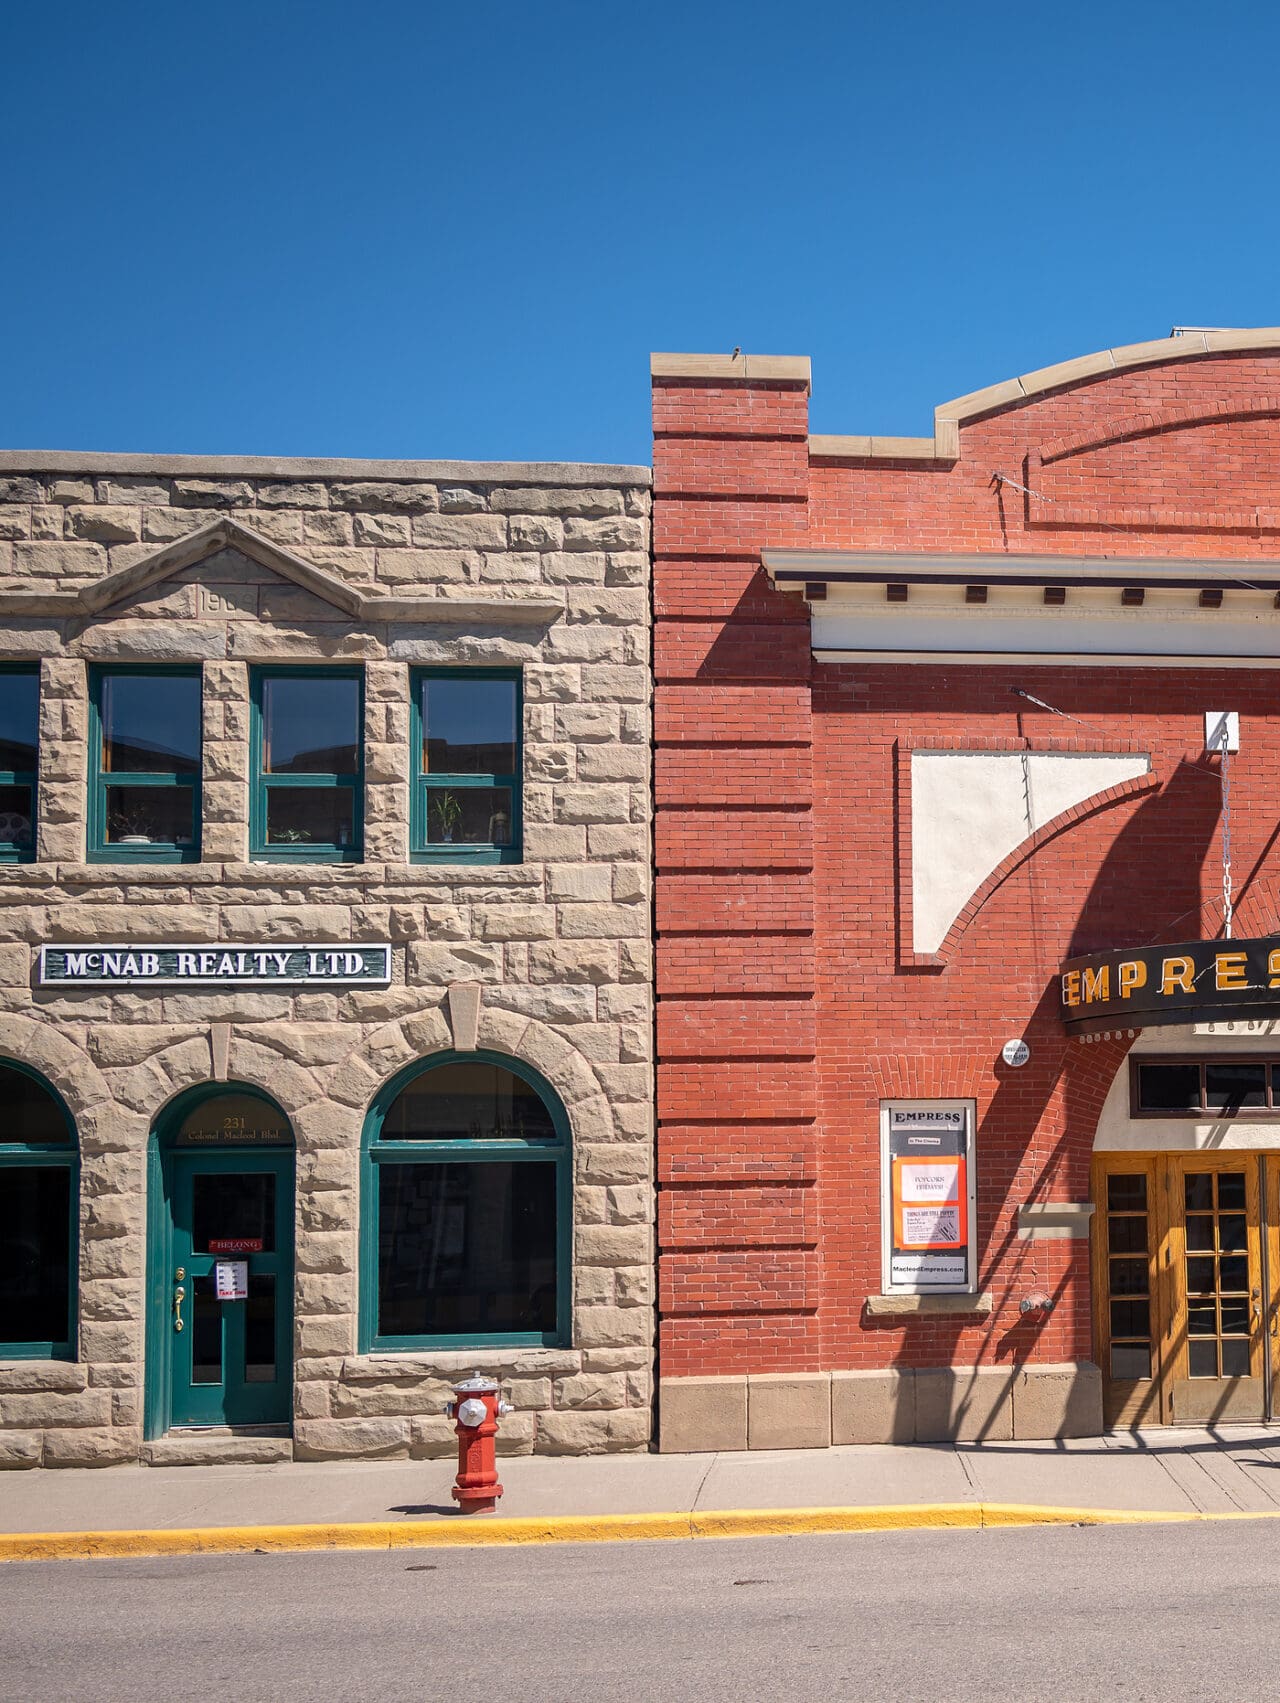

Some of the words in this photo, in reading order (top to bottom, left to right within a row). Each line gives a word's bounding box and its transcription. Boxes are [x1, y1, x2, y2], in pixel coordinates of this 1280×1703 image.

[177, 953, 292, 976] REALTY
[307, 952, 370, 976] LTD.
[895, 1112, 960, 1122] EMPRESS
[223, 1117, 245, 1129] 231
[188, 1130, 219, 1140] Colonel
[217, 1240, 257, 1249] BELONG
